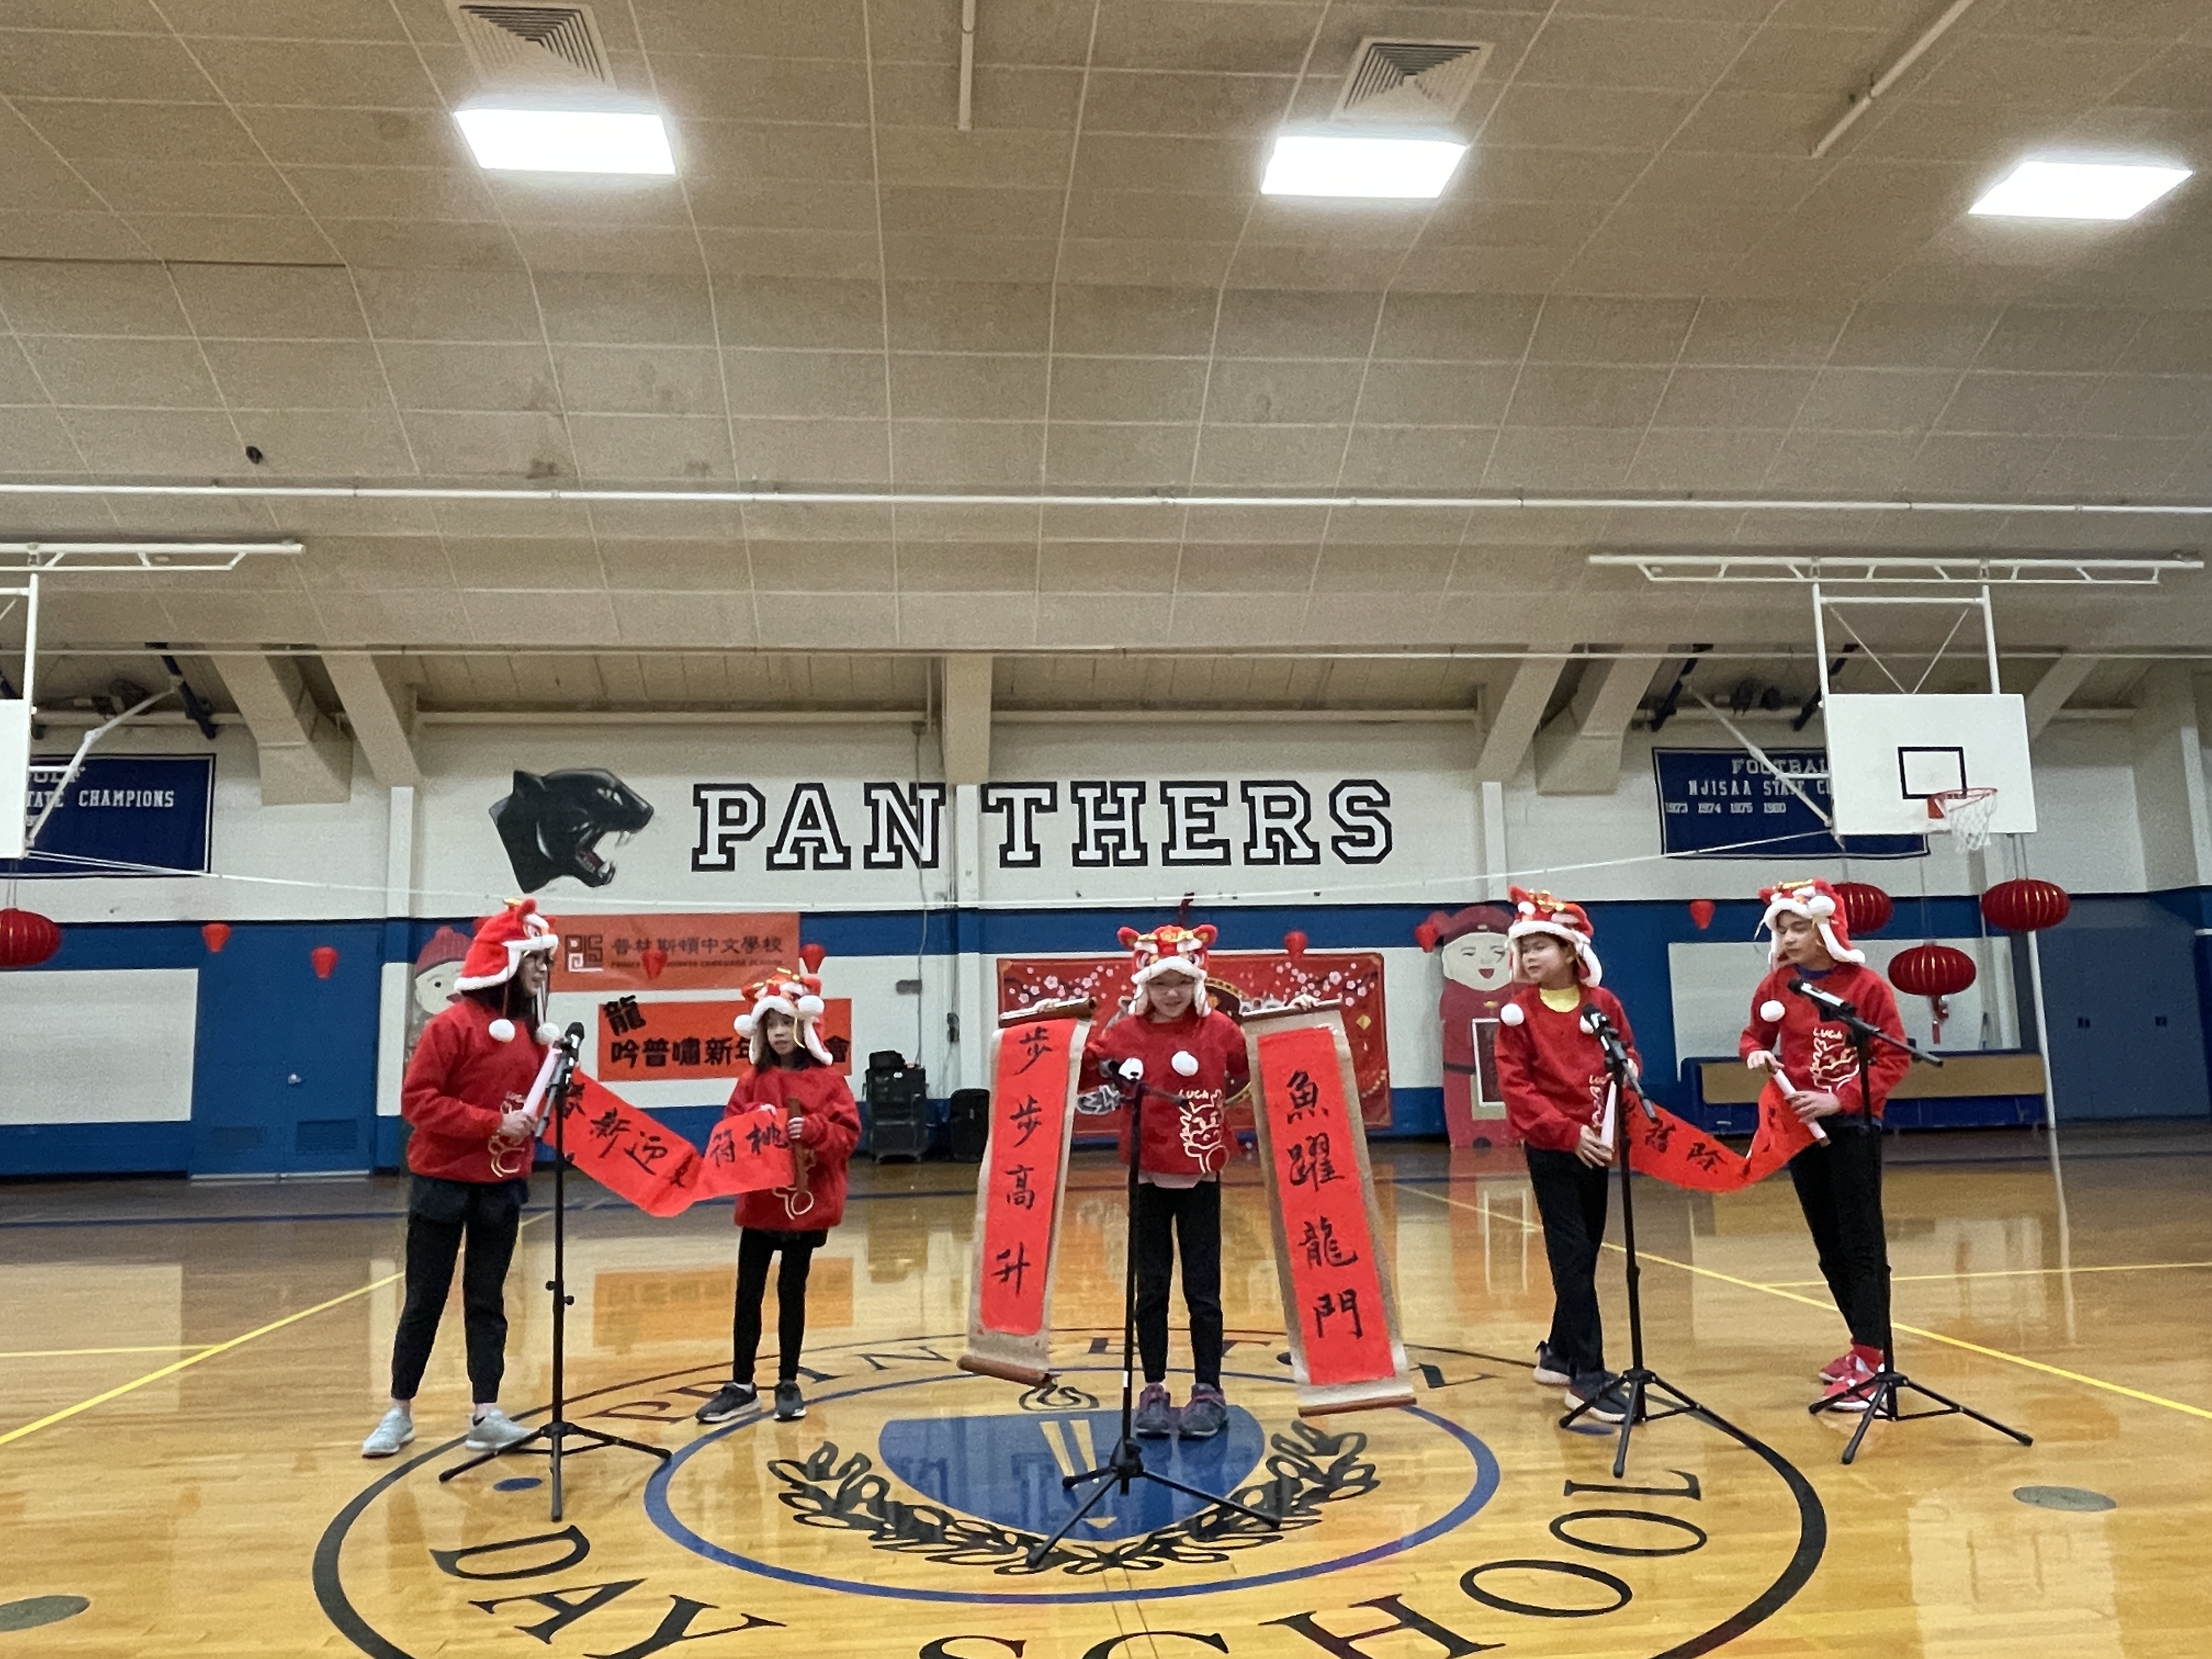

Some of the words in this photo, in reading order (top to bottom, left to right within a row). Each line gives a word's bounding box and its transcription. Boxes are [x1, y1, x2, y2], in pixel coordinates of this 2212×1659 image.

[26, 791, 64, 808] TATE
[78, 790, 174, 808] CHAMPIONS
[1731, 759, 1829, 774] FOOTBAL
[691, 779, 1392, 871] PANTHERS
[991, 1026, 1052, 1296] 步步高升
[1285, 1070, 1364, 1339] 魚躍龍門
[429, 1525, 787, 1659] DAY
